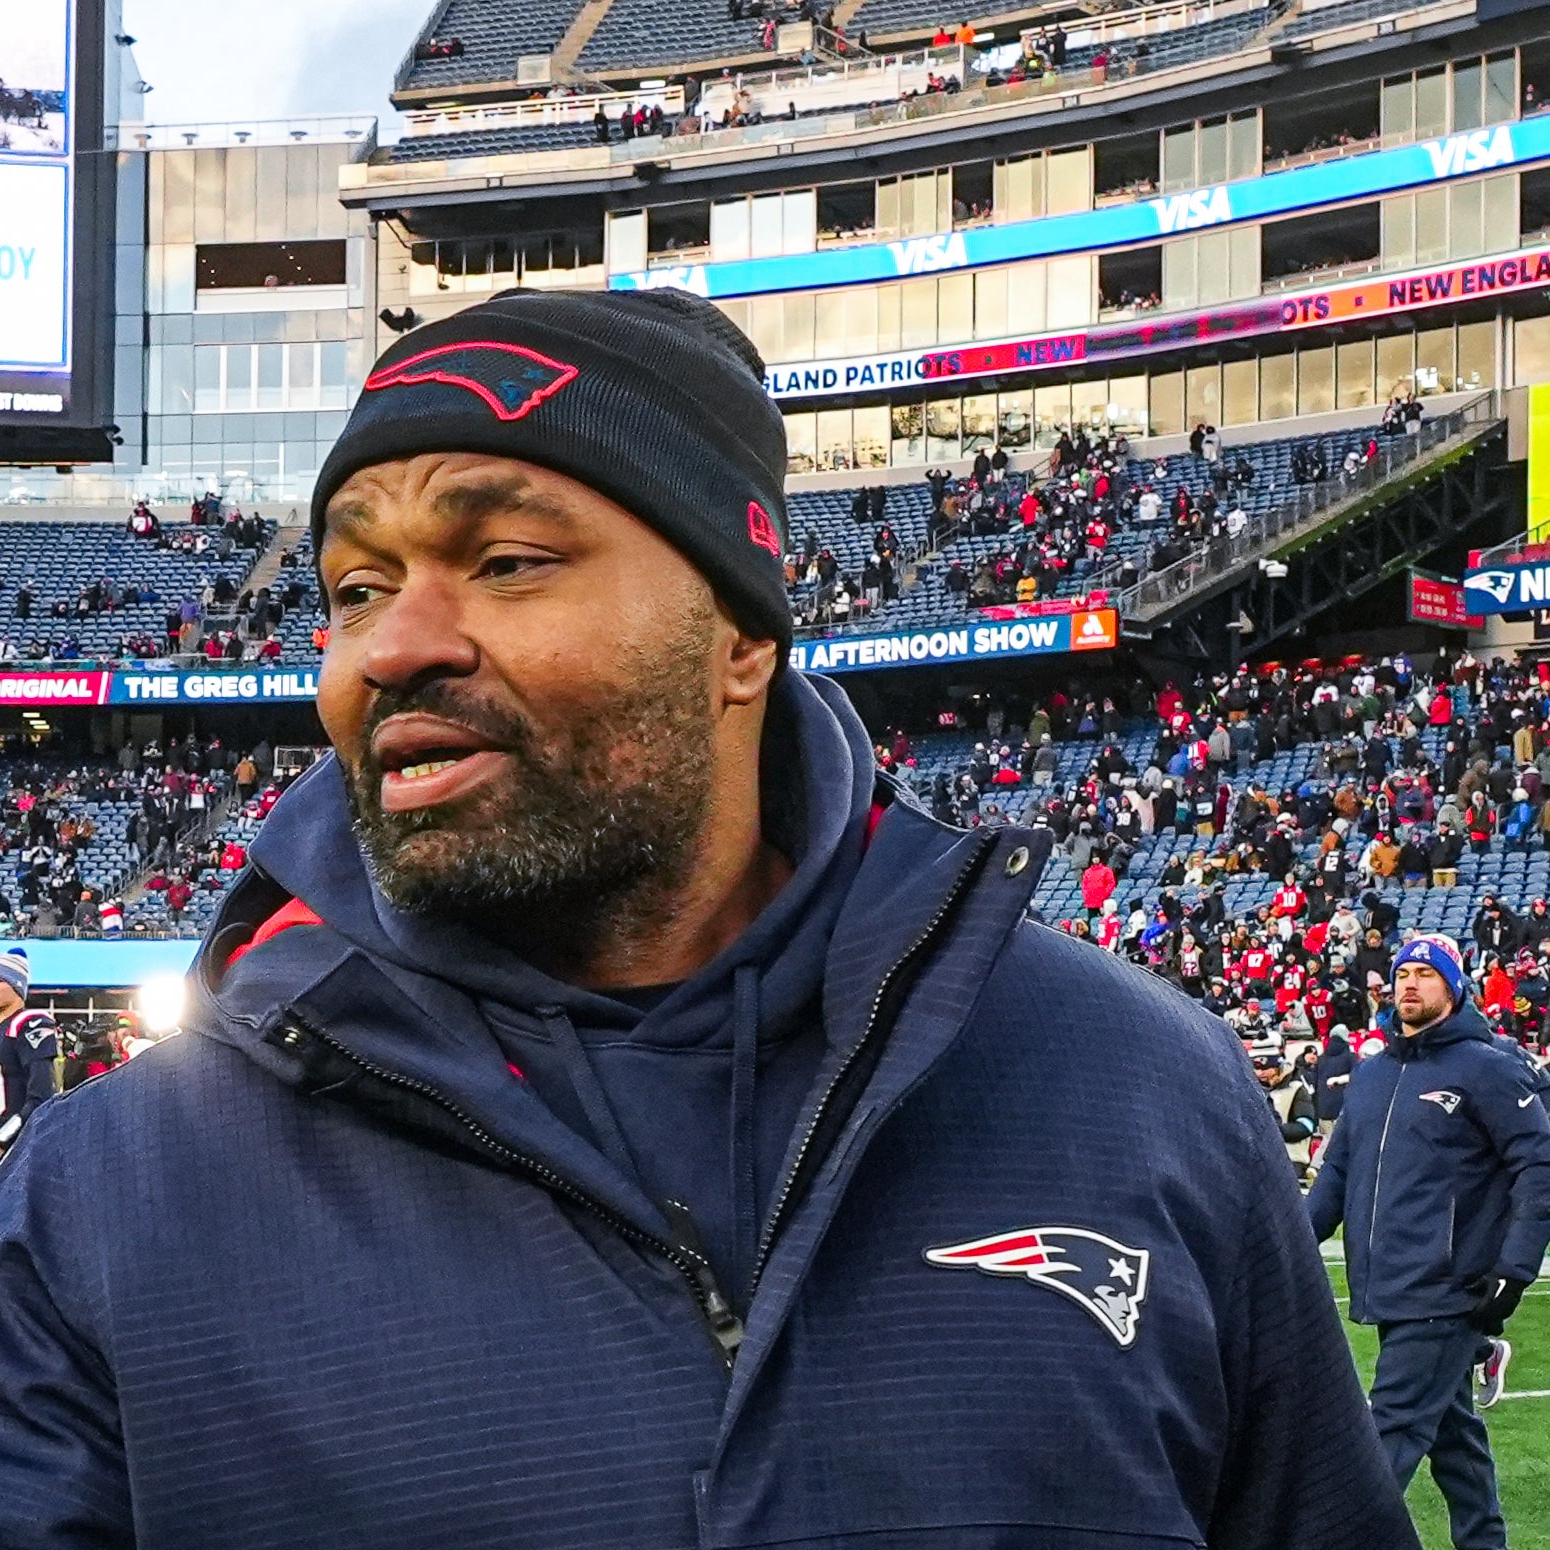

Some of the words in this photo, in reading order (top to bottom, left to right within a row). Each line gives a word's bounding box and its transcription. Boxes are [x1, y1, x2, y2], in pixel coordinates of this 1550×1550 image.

[1421, 125, 1515, 178] VISA
[1149, 186, 1232, 234] VISA
[887, 232, 970, 276] VISA
[1388, 271, 1453, 308] NEW
[846, 352, 961, 387] PATRIOTS
[1016, 338, 1078, 366] NEW
[810, 629, 968, 669] AFTERNOON
[974, 621, 1058, 654] SHOW
[124, 676, 194, 698] THE
[198, 675, 258, 698] GREG
